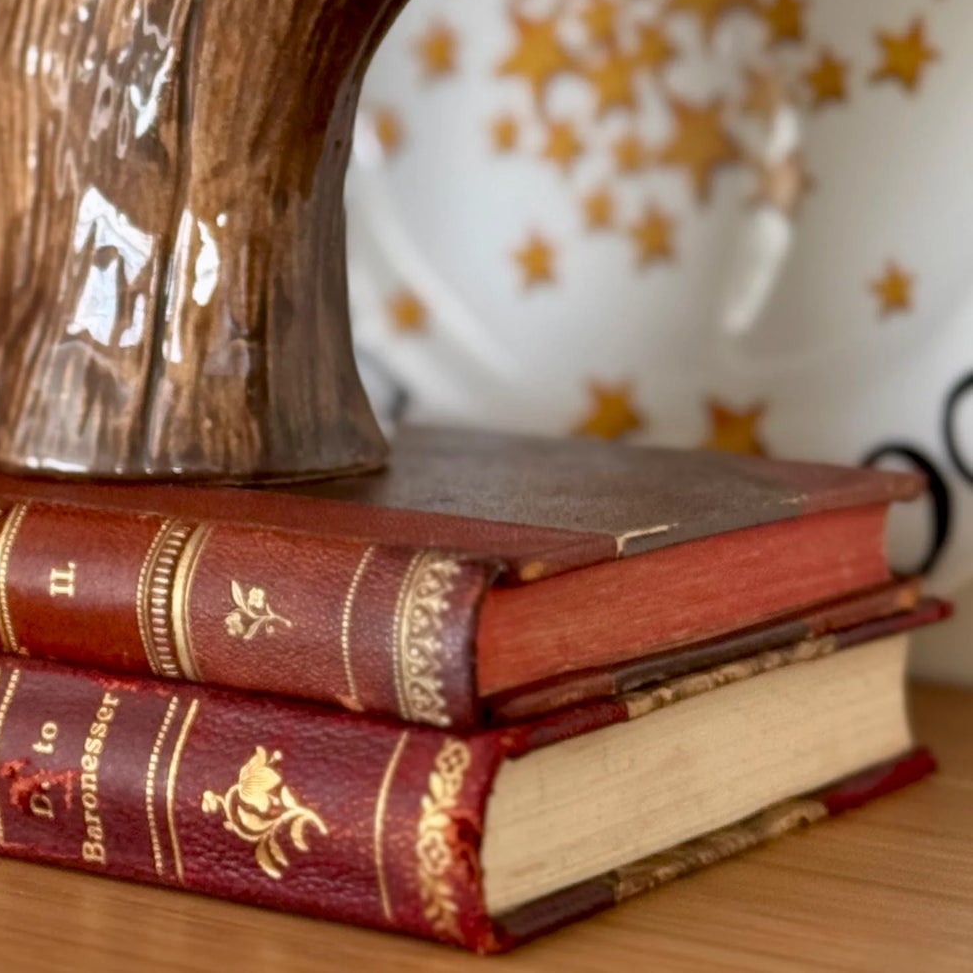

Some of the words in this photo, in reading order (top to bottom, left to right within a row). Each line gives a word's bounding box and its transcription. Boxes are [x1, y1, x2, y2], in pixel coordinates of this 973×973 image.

[49, 561, 76, 598] II.
[32, 721, 58, 754] to
[81, 692, 120, 865] Baronesser
